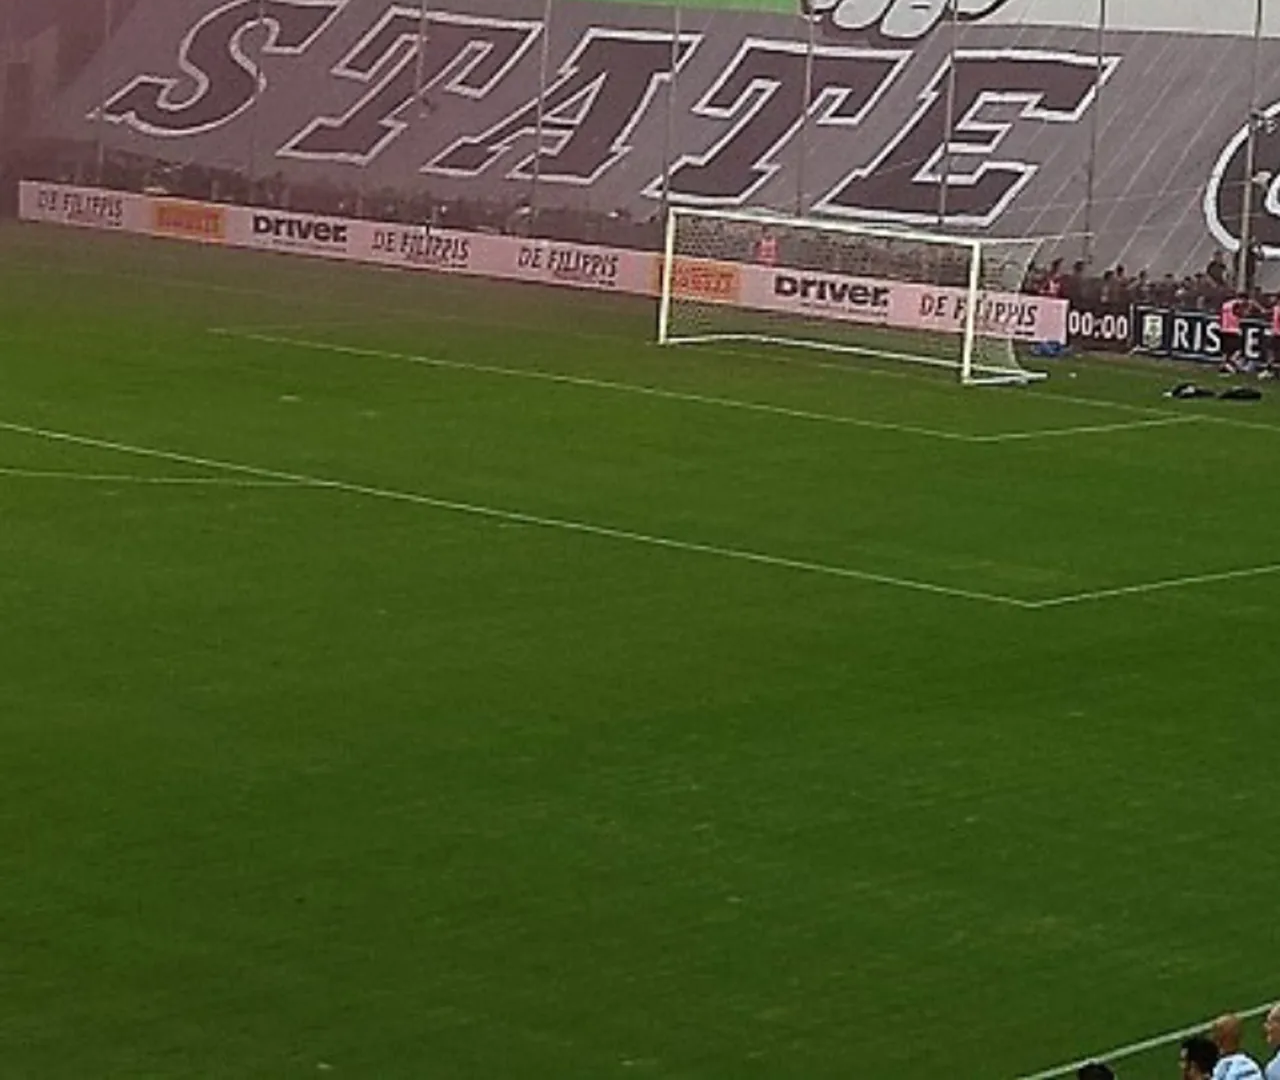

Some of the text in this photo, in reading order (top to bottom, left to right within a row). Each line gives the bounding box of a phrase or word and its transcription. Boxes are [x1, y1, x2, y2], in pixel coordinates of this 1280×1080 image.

[38, 189, 57, 211] DE
[372, 231, 395, 253] DE
[518, 246, 544, 267] DE
[919, 293, 948, 317] DE
[954, 295, 1038, 326] FLIPPIS
[1069, 311, 1128, 339] 00:00
